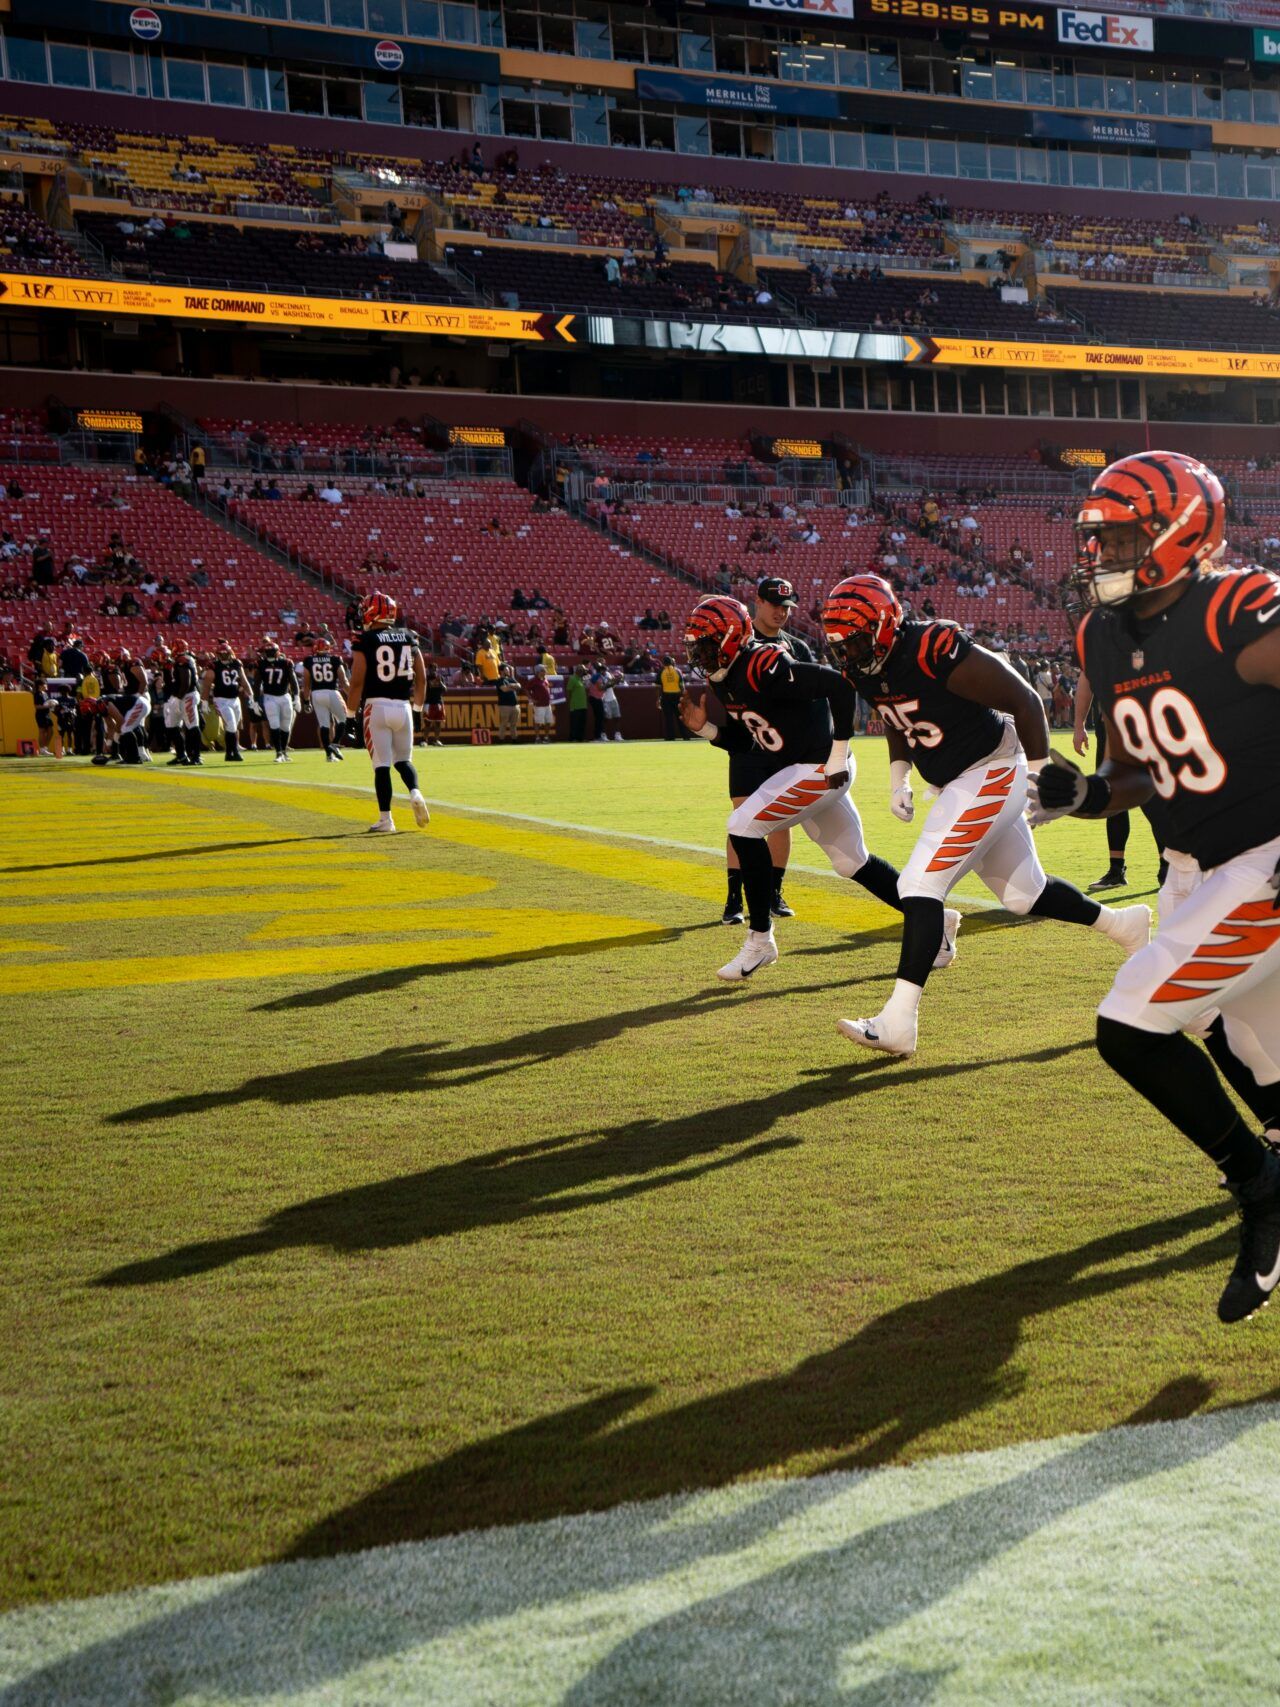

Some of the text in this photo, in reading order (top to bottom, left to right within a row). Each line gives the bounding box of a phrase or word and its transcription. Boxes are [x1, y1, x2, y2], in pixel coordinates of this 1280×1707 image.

[871, 0, 1044, 30] 5:29:55 PM
[132, 18, 160, 29] PEPSI
[1062, 12, 1138, 46] FedEx
[376, 50, 402, 60] PEPSI
[706, 88, 753, 101] MERRILL
[1093, 126, 1135, 137] MERRILL
[40, 161, 61, 172] 340
[403, 196, 421, 207] 341
[719, 223, 736, 233] 342
[184, 295, 265, 314] TAKE COMMAND
[270, 302, 311, 311] CINCINNATI
[283, 310, 325, 319] WASHINGTON
[340, 307, 369, 315] BENGALS
[1085, 352, 1103, 364] TAKE
[1104, 353, 1143, 365] COMMAND
[377, 632, 408, 643] WILCOX
[601, 637, 614, 649] 21
[376, 645, 415, 682] 84
[221, 669, 239, 686] 62
[265, 668, 284, 685] 77
[312, 663, 334, 682] 66
[1113, 670, 1172, 694] BENGALS
[474, 730, 490, 741] 10
[1112, 685, 1228, 800] 99
